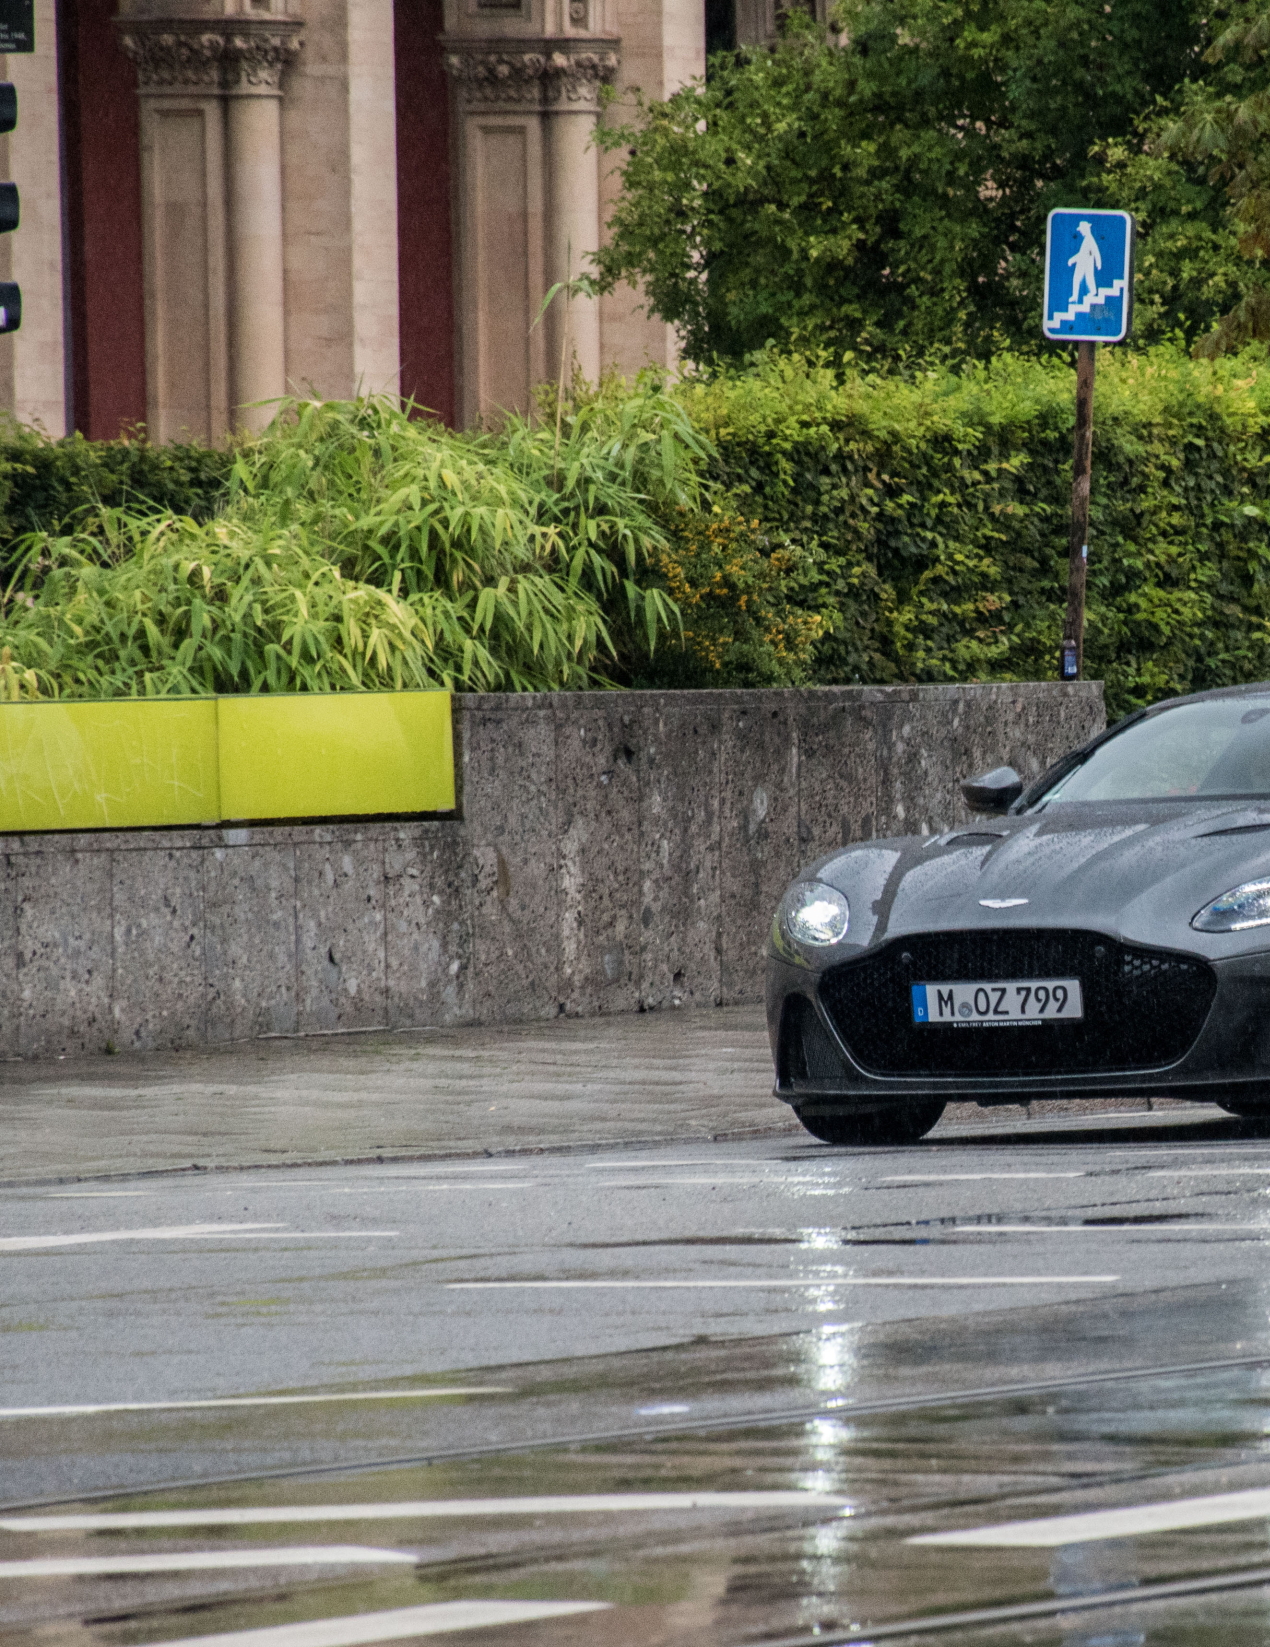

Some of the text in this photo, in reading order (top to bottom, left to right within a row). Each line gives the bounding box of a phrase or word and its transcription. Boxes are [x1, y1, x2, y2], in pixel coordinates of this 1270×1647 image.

[917, 1007, 925, 1017] D
[936, 985, 1069, 1018] M OZ 799
